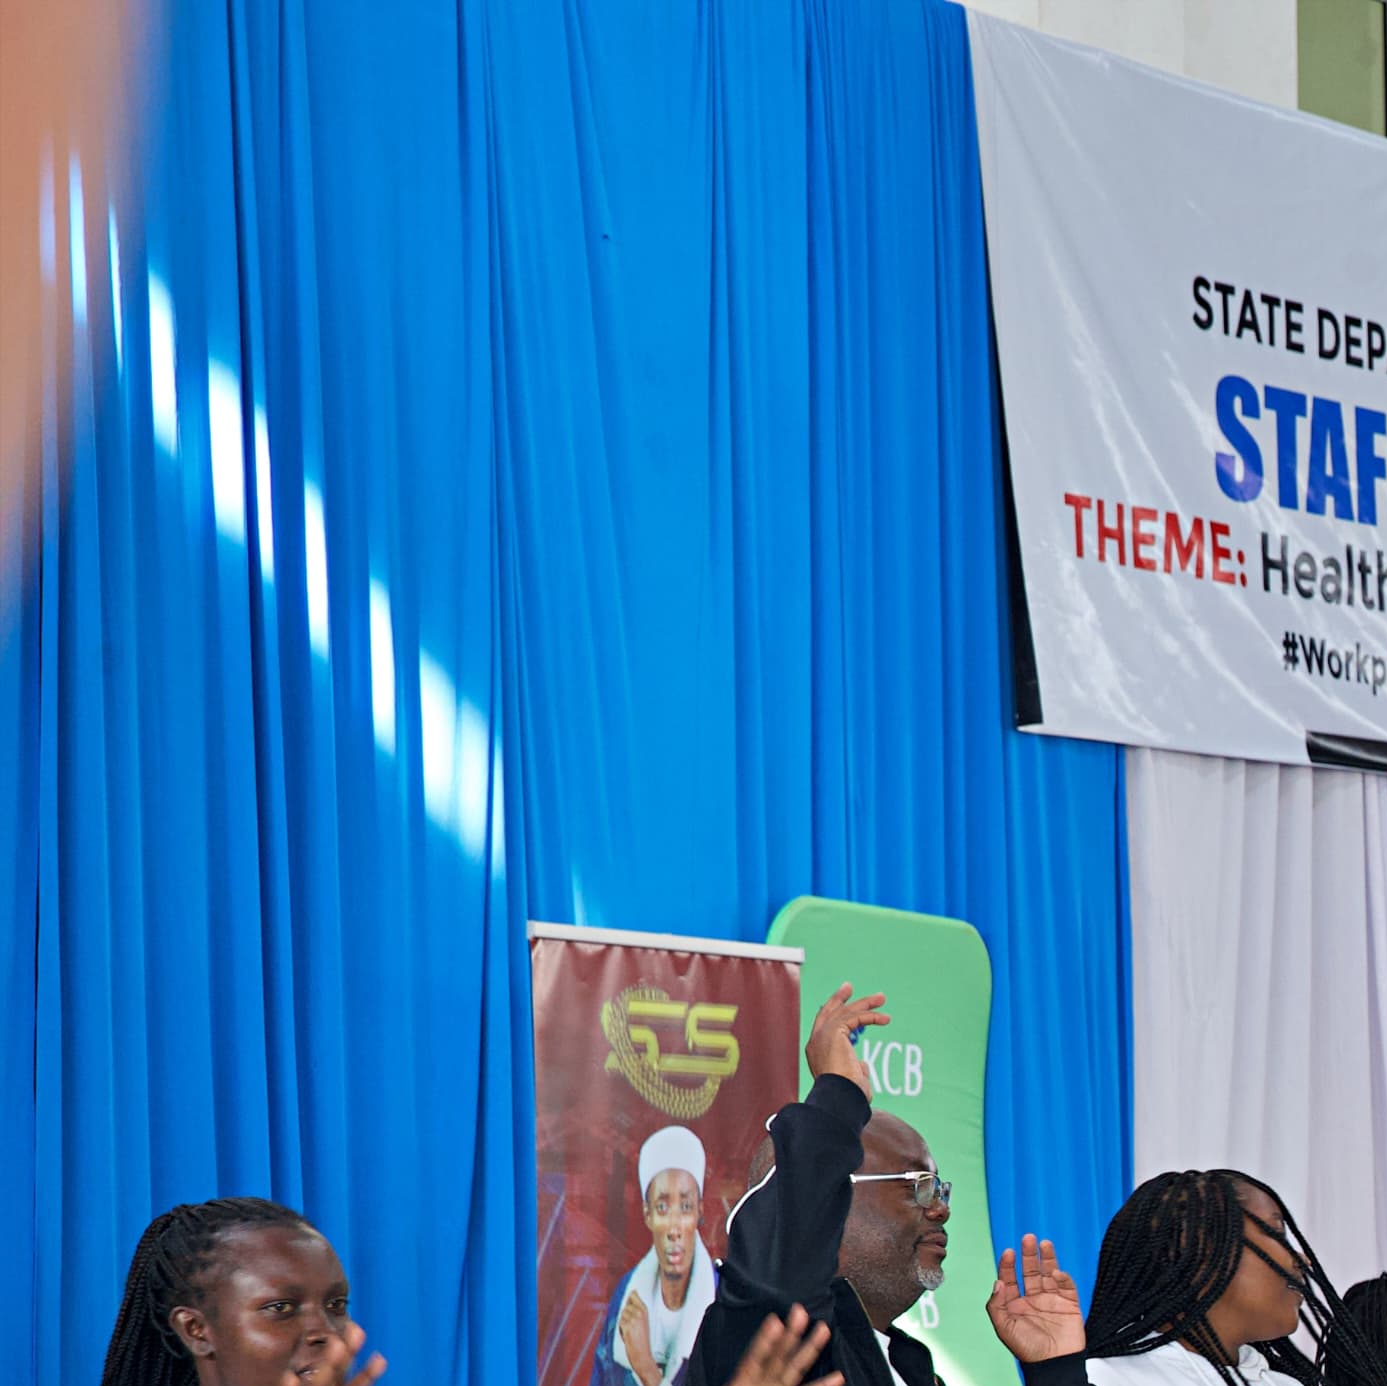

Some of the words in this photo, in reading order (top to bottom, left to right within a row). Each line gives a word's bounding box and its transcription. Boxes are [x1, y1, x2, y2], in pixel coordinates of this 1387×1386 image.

[1192, 274, 1305, 354] STATE
[1064, 492, 1248, 589] THEME:
[863, 1039, 923, 1097] KCB
